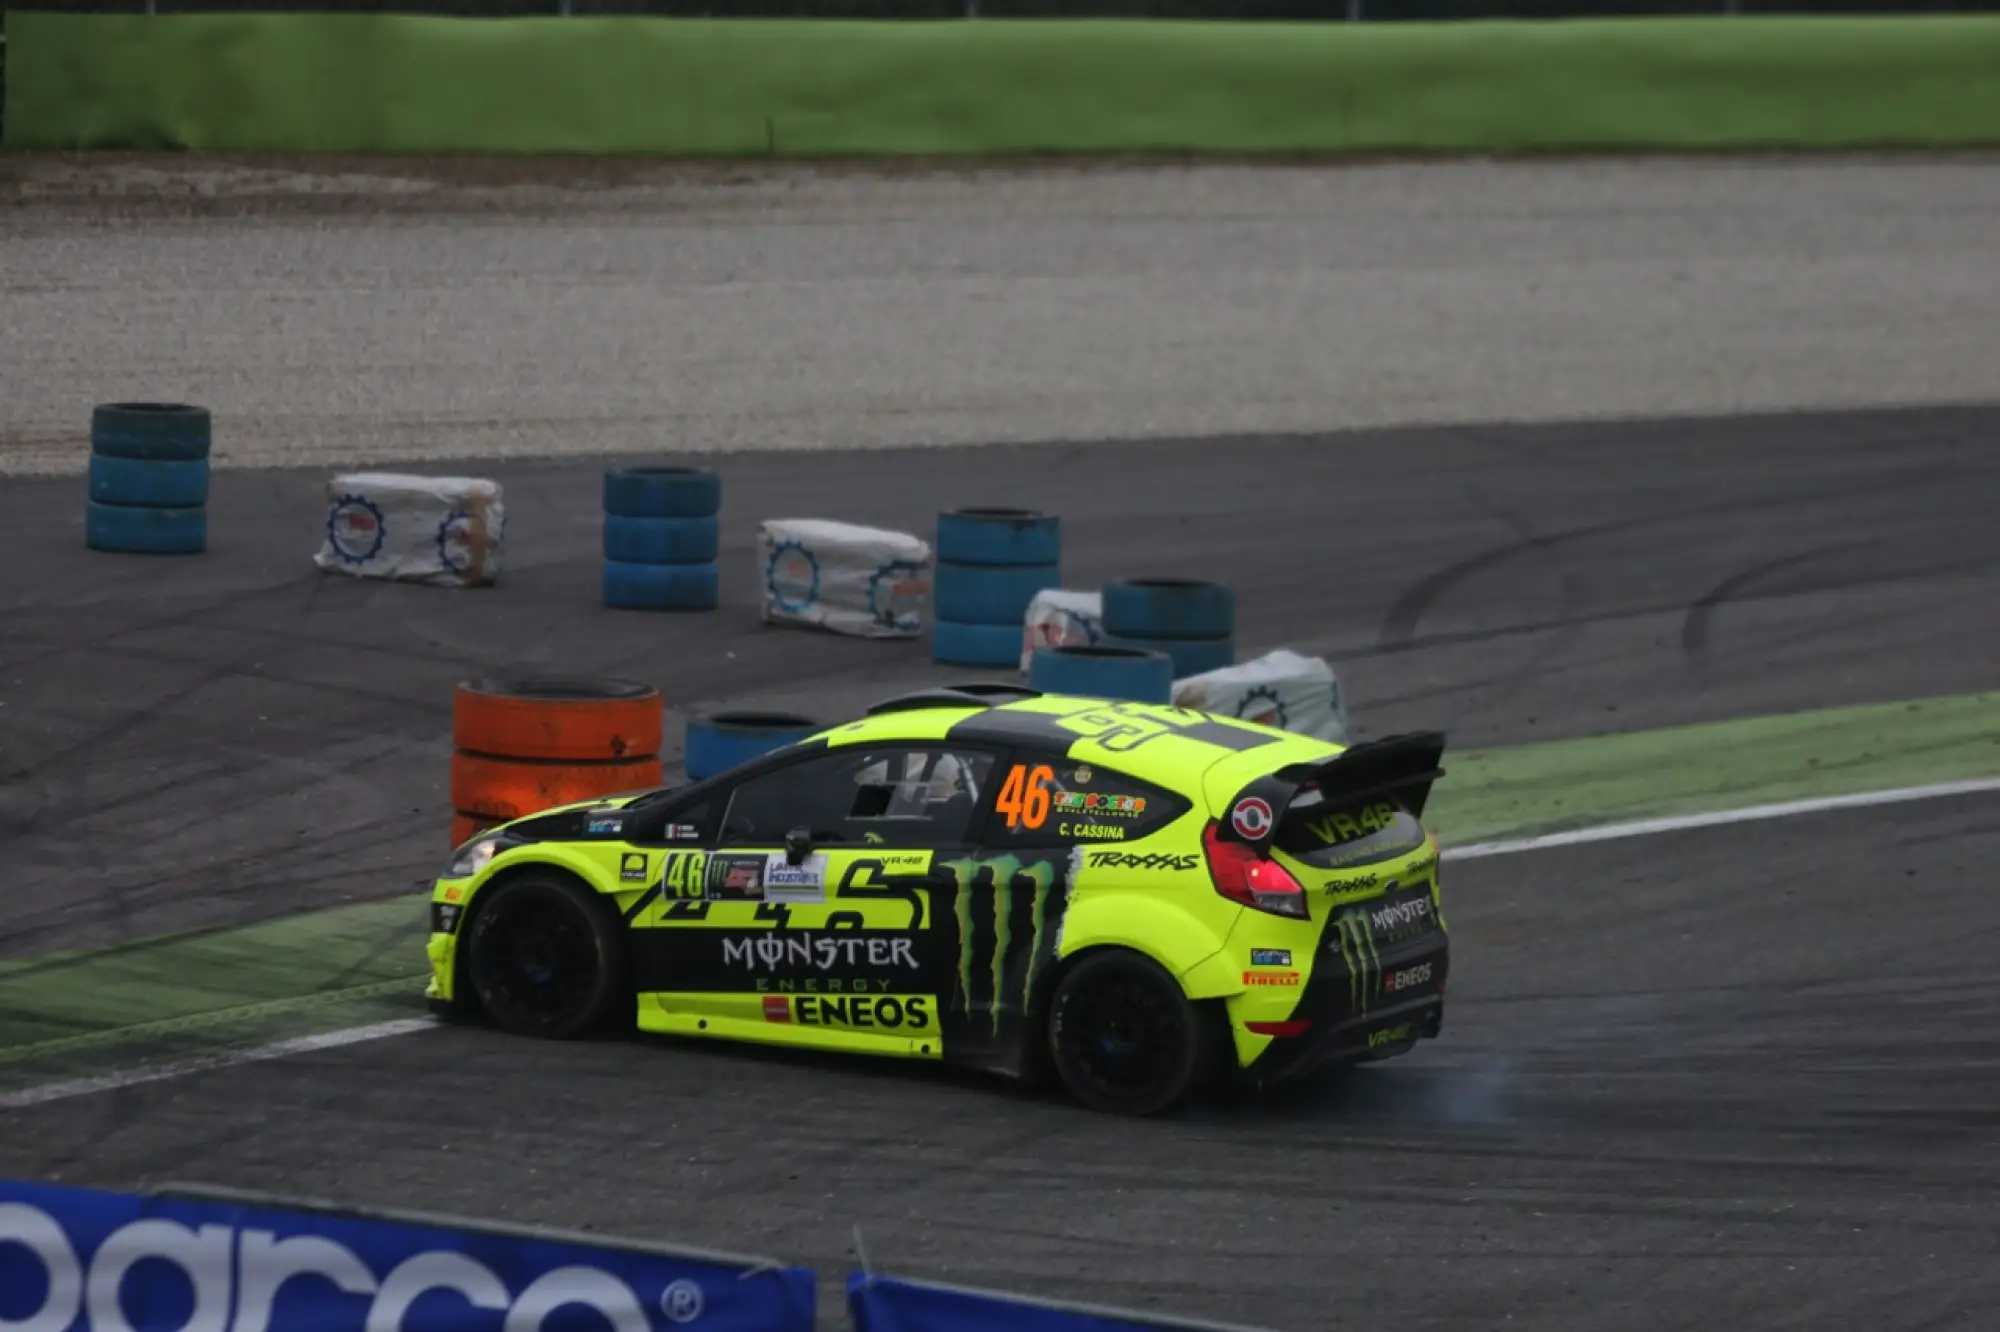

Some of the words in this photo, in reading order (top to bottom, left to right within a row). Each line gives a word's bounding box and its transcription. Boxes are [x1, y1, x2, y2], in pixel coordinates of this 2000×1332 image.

[995, 764, 1054, 829] 46
[1073, 823, 1125, 840] CASSINA
[667, 852, 706, 898] 46
[1088, 851, 1200, 871] TRAXXAS
[722, 931, 919, 972] MONSTER
[756, 978, 891, 992] ENERGY
[1395, 962, 1432, 990] ENEOS
[795, 996, 929, 1029] ENEOS
